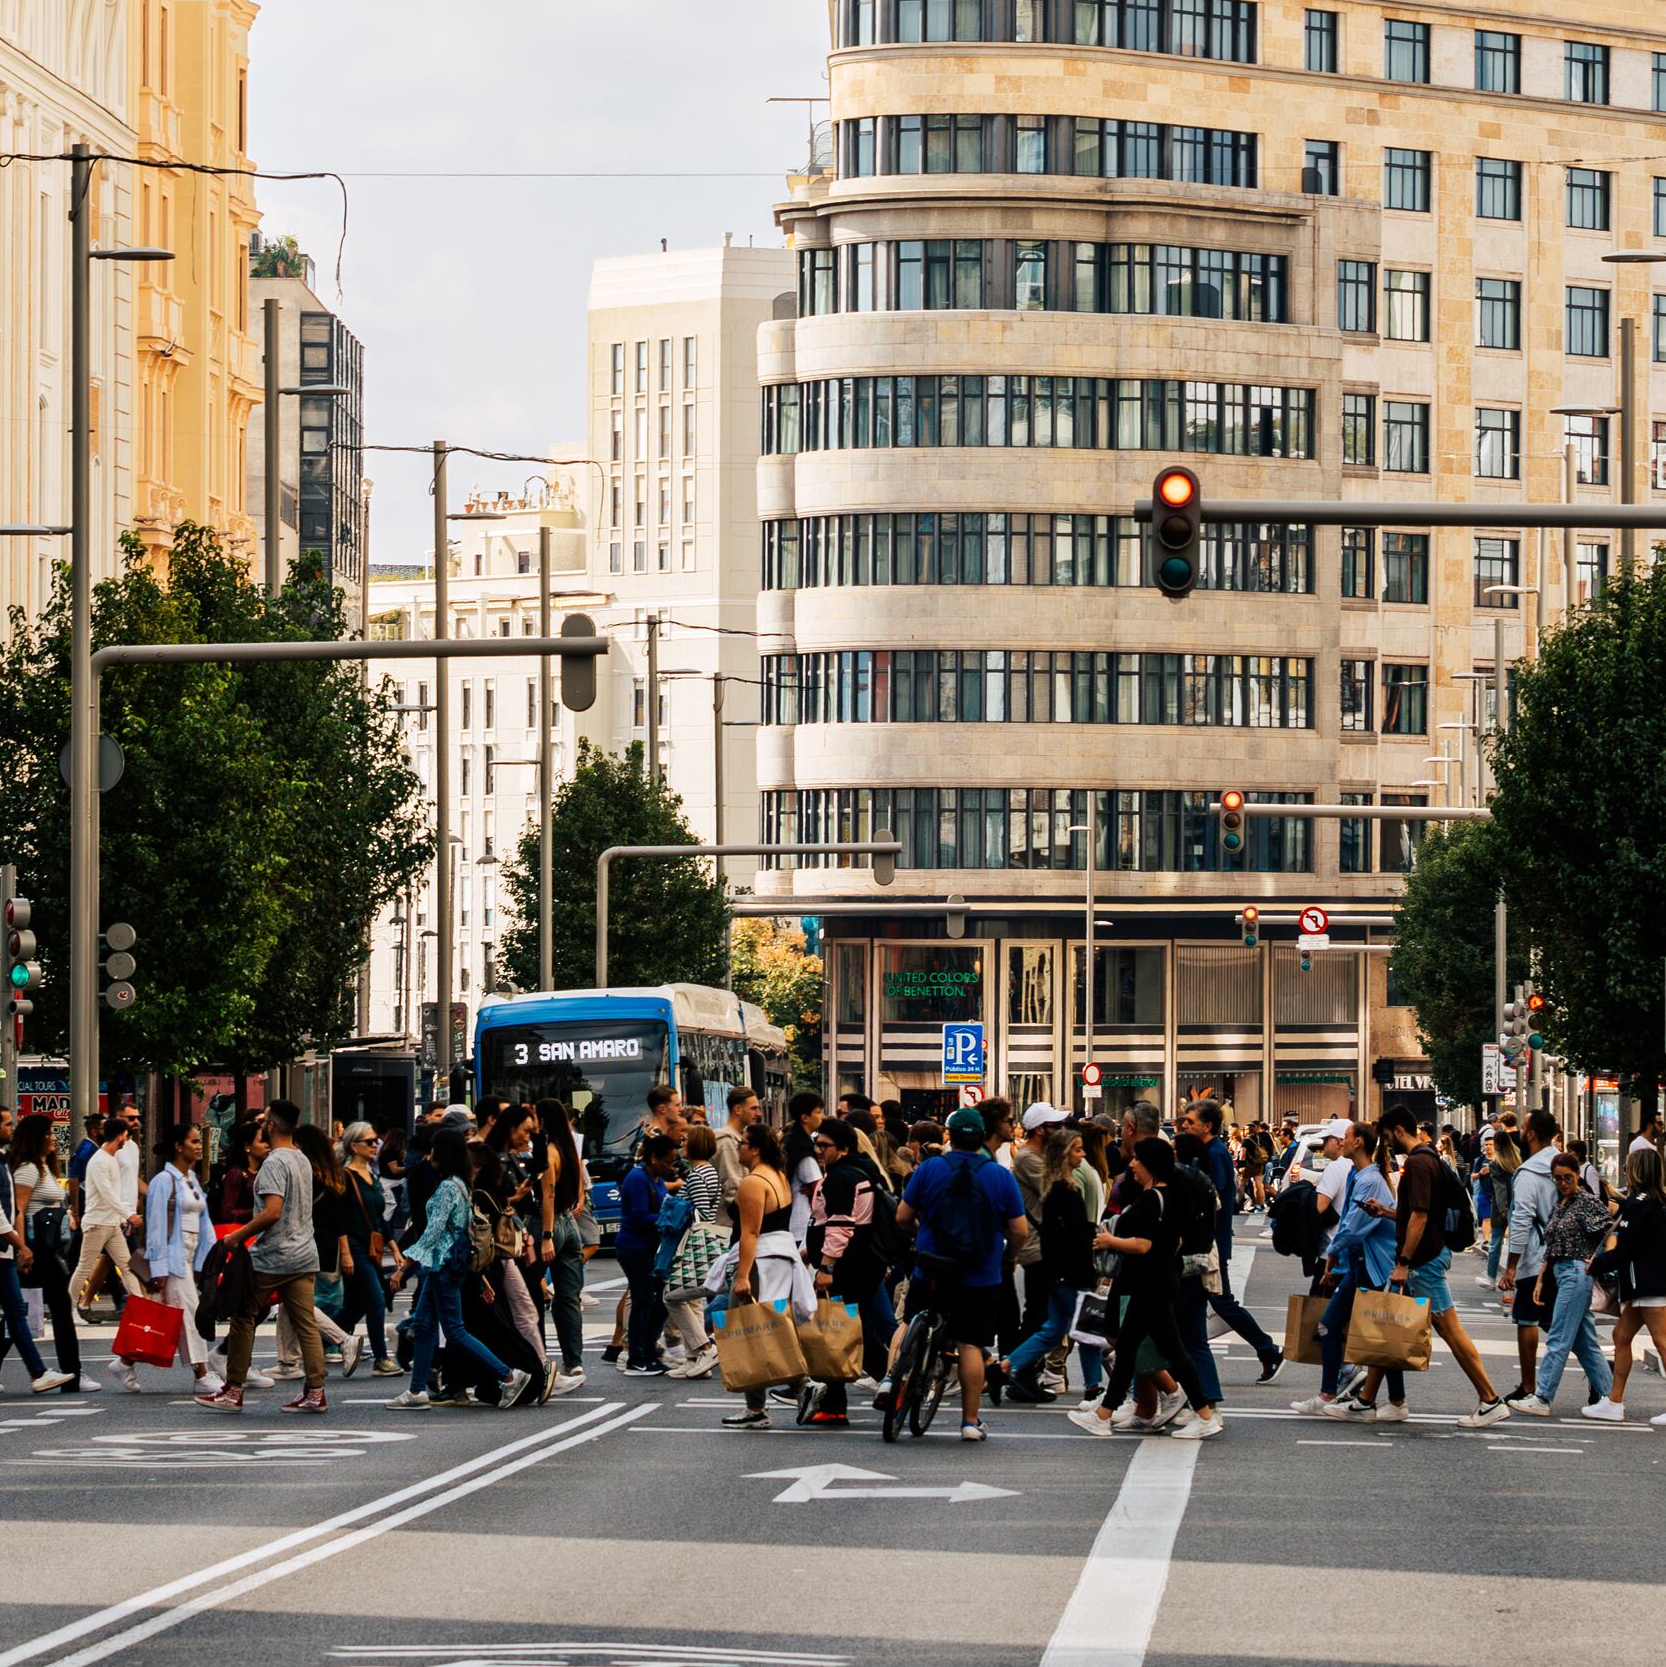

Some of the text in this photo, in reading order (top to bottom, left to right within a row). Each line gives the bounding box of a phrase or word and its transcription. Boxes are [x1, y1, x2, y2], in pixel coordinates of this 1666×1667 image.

[885, 972, 979, 983] UNITED COLORS
[514, 1038, 639, 1065] 3 SAN AMARO
[953, 1032, 977, 1065] P
[17, 1081, 56, 1091] CIAL TOURS
[32, 1095, 71, 1113] MAD
